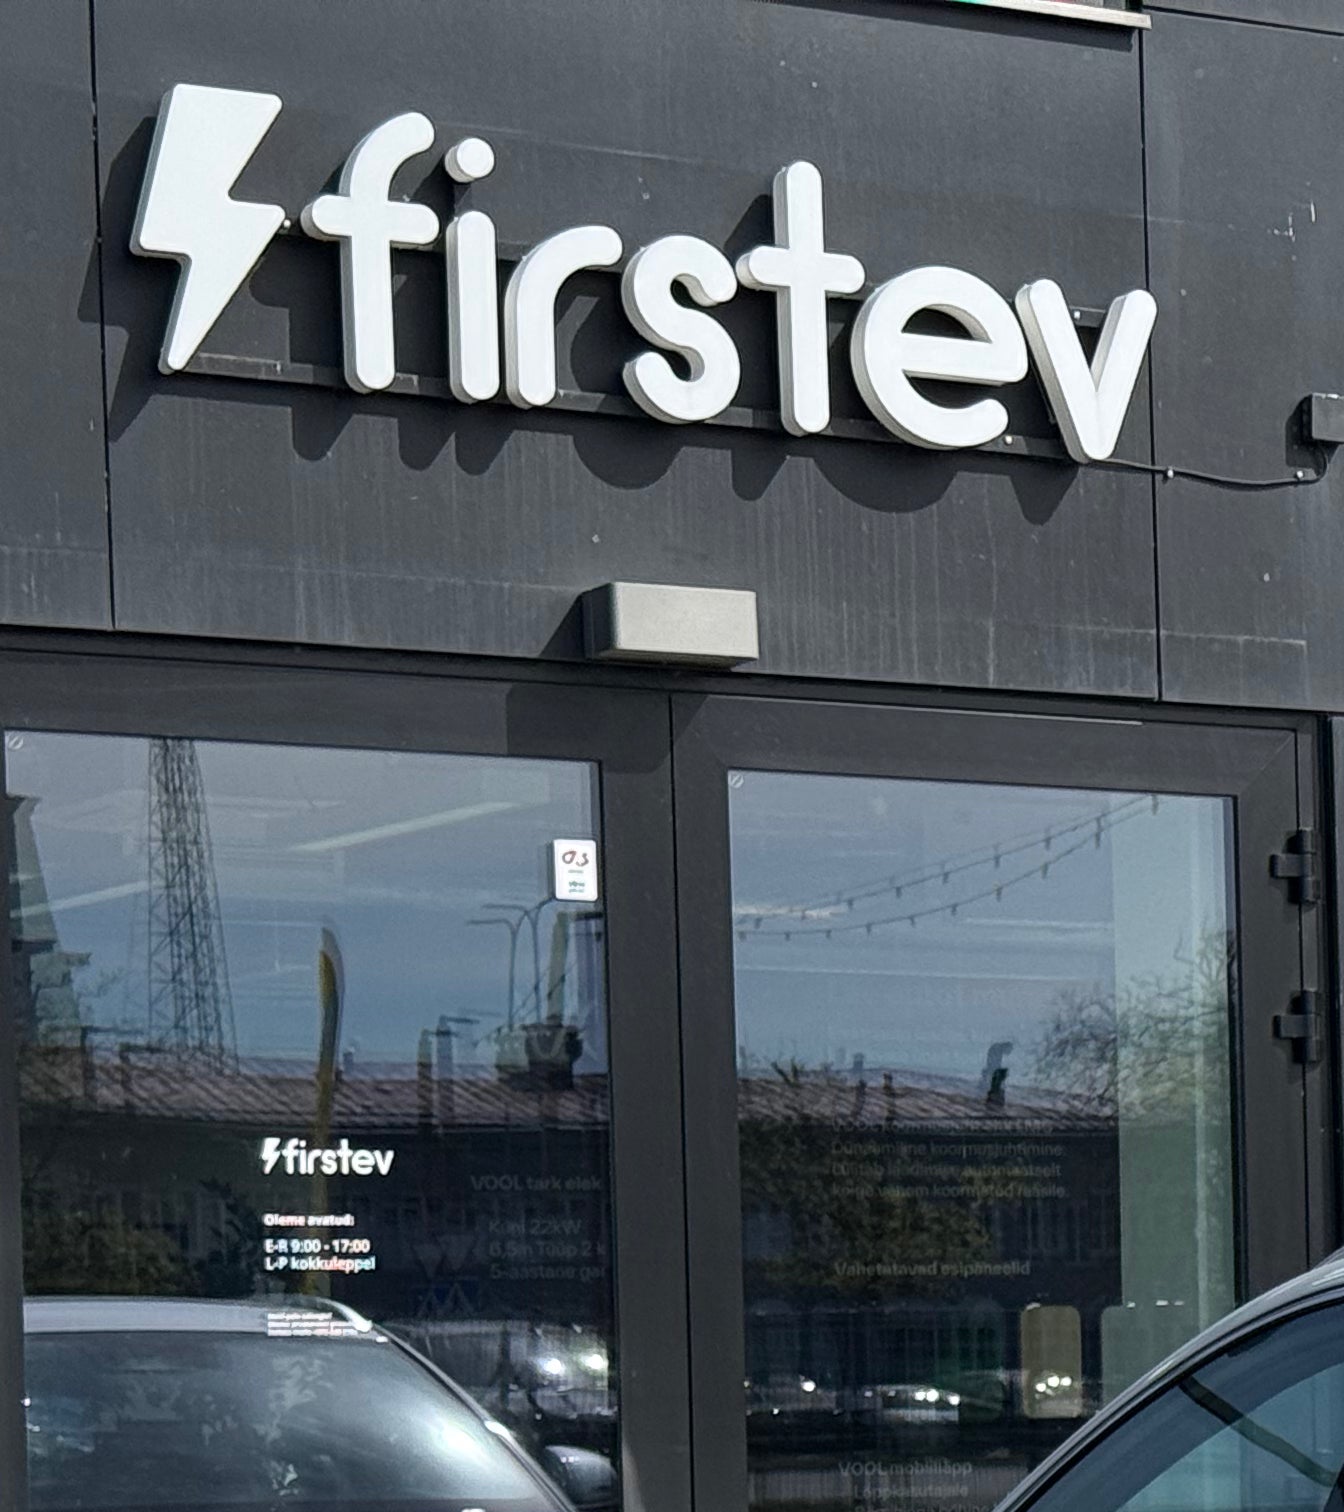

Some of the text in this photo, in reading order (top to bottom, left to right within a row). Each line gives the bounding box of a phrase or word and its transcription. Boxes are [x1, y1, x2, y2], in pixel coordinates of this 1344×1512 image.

[302, 112, 1157, 463] firstev
[281, 1137, 395, 1176] firstev
[290, 1238, 321, 1254] 9:00
[332, 1238, 371, 1254] 17:00
